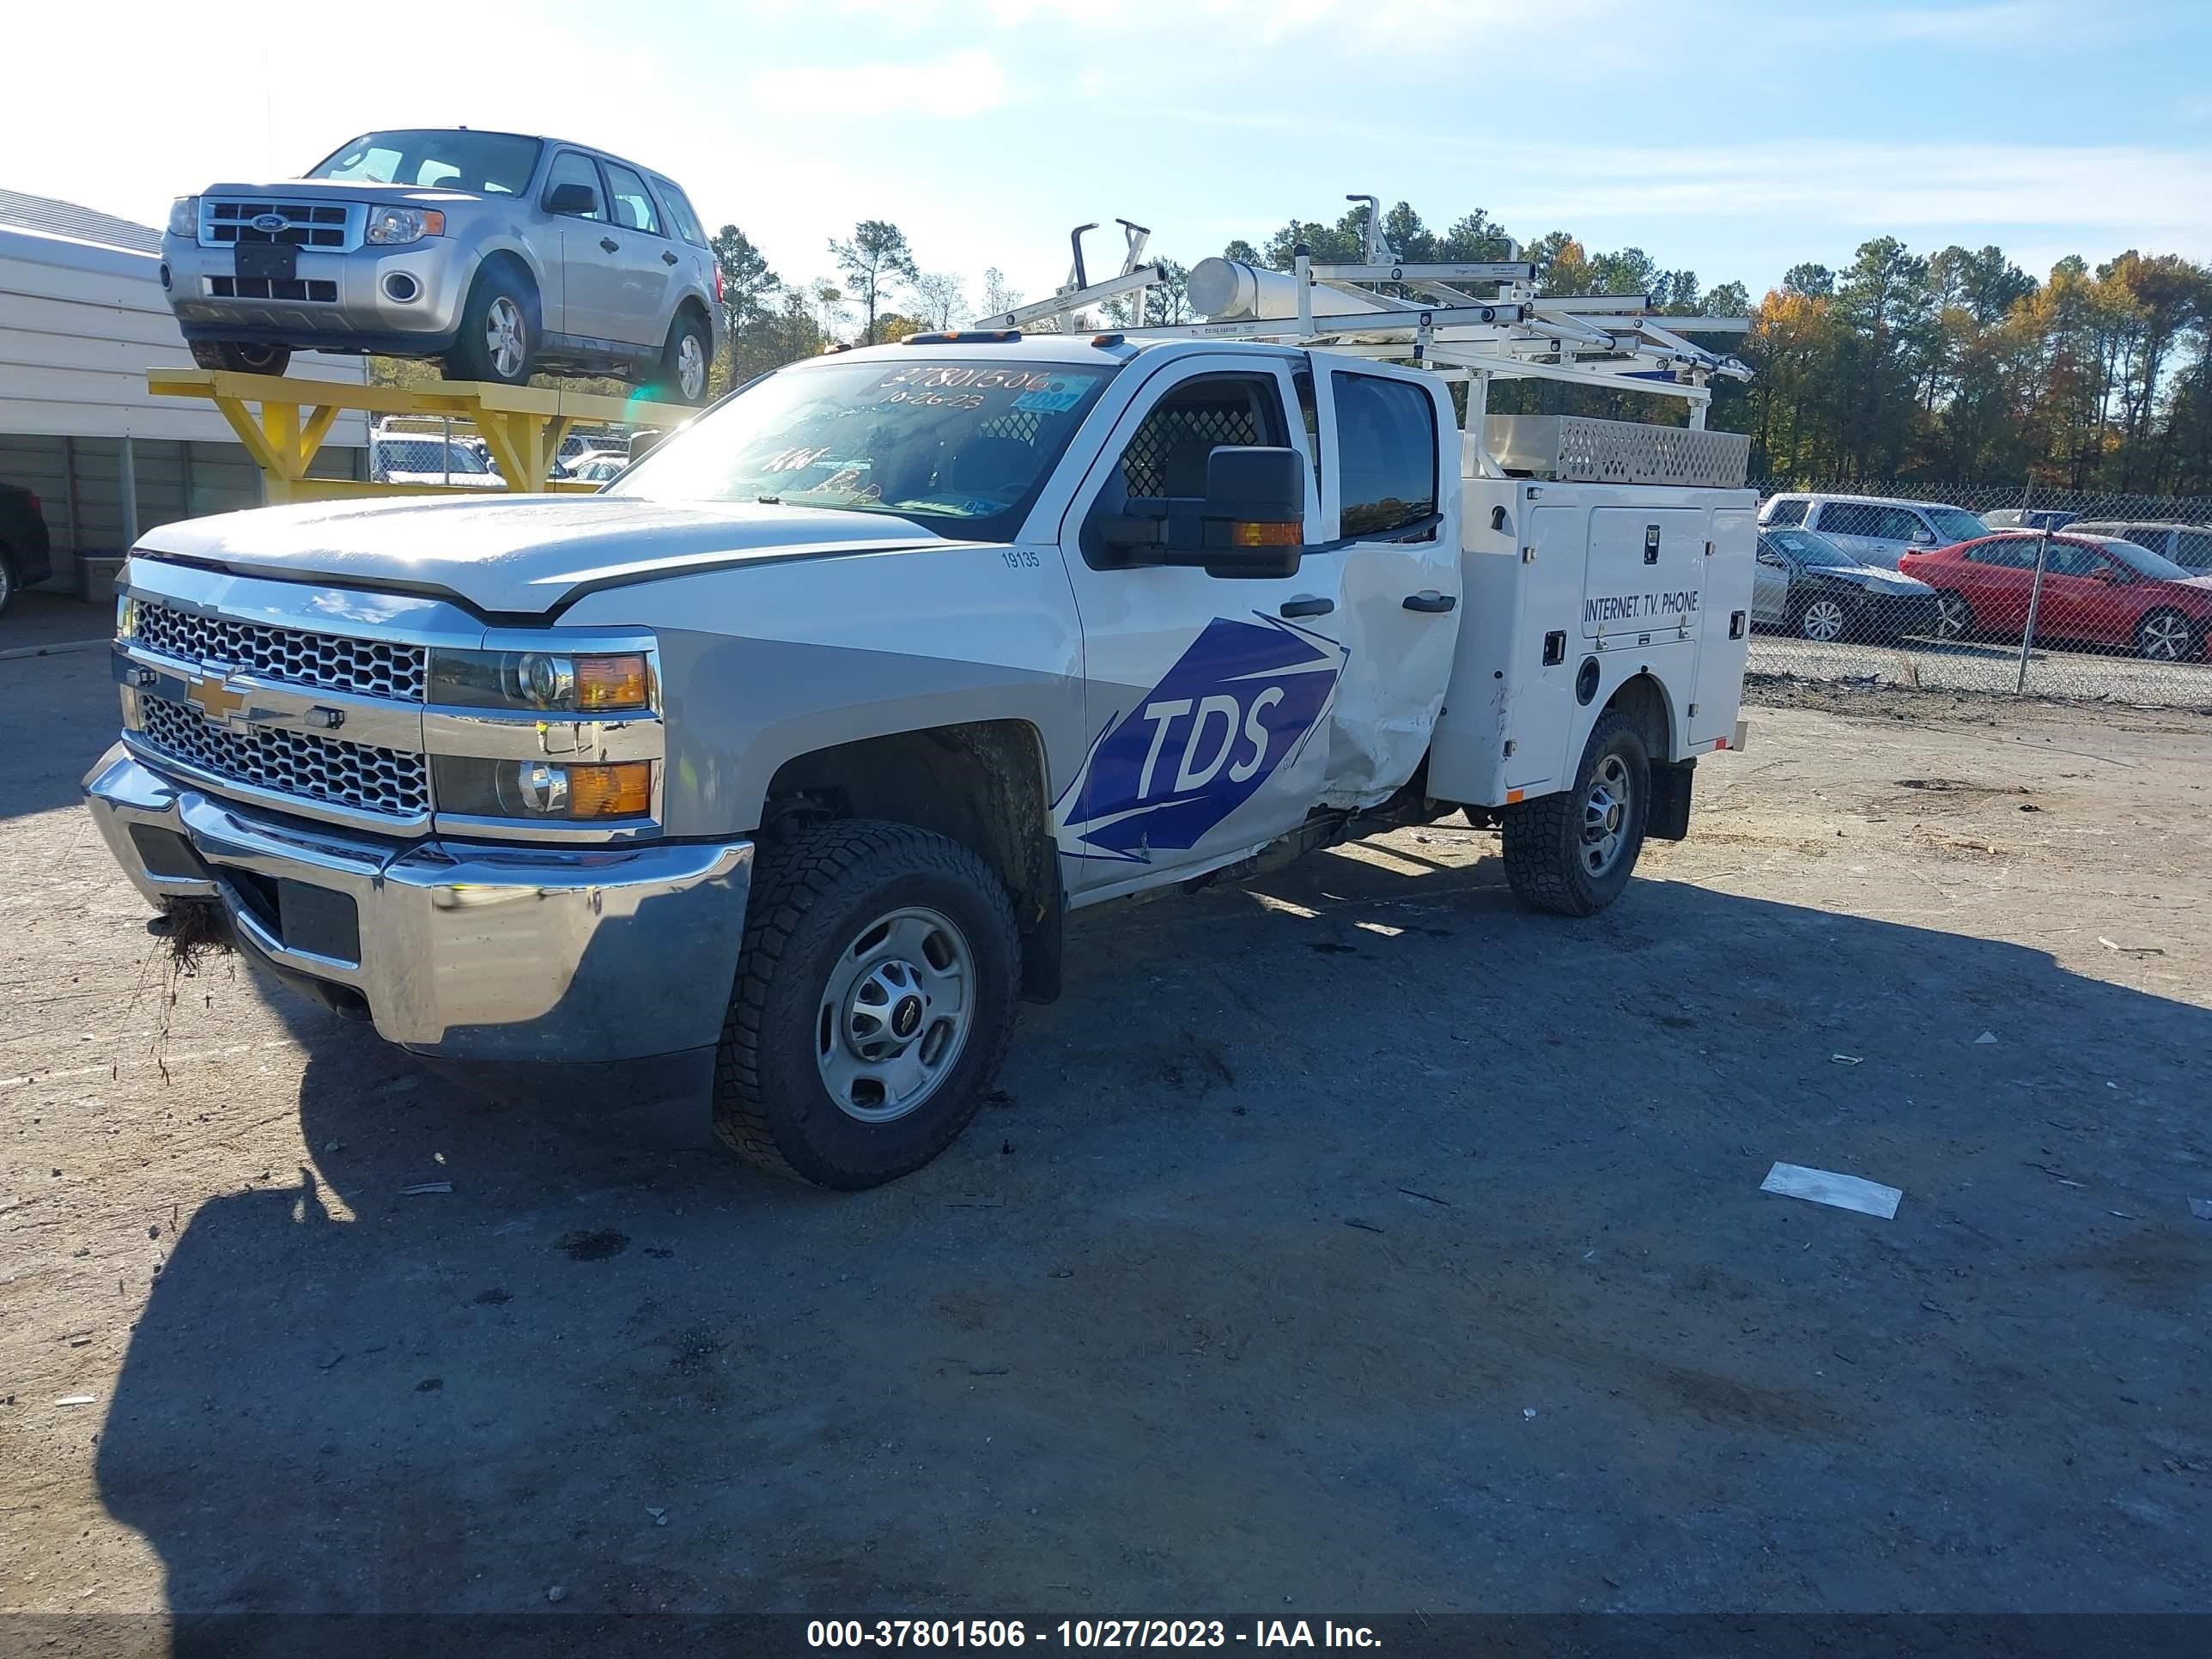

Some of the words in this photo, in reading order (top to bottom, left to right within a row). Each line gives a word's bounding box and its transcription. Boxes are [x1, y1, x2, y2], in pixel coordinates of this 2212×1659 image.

[879, 367, 1050, 392] 37801506
[879, 391, 984, 410] 10-26-23
[1001, 551, 1040, 568] 19135
[1585, 596, 1639, 622] INTERNET.
[1644, 592, 1659, 616] TV.
[1662, 590, 1700, 615] PHONE.
[1137, 687, 1285, 799] TDS
